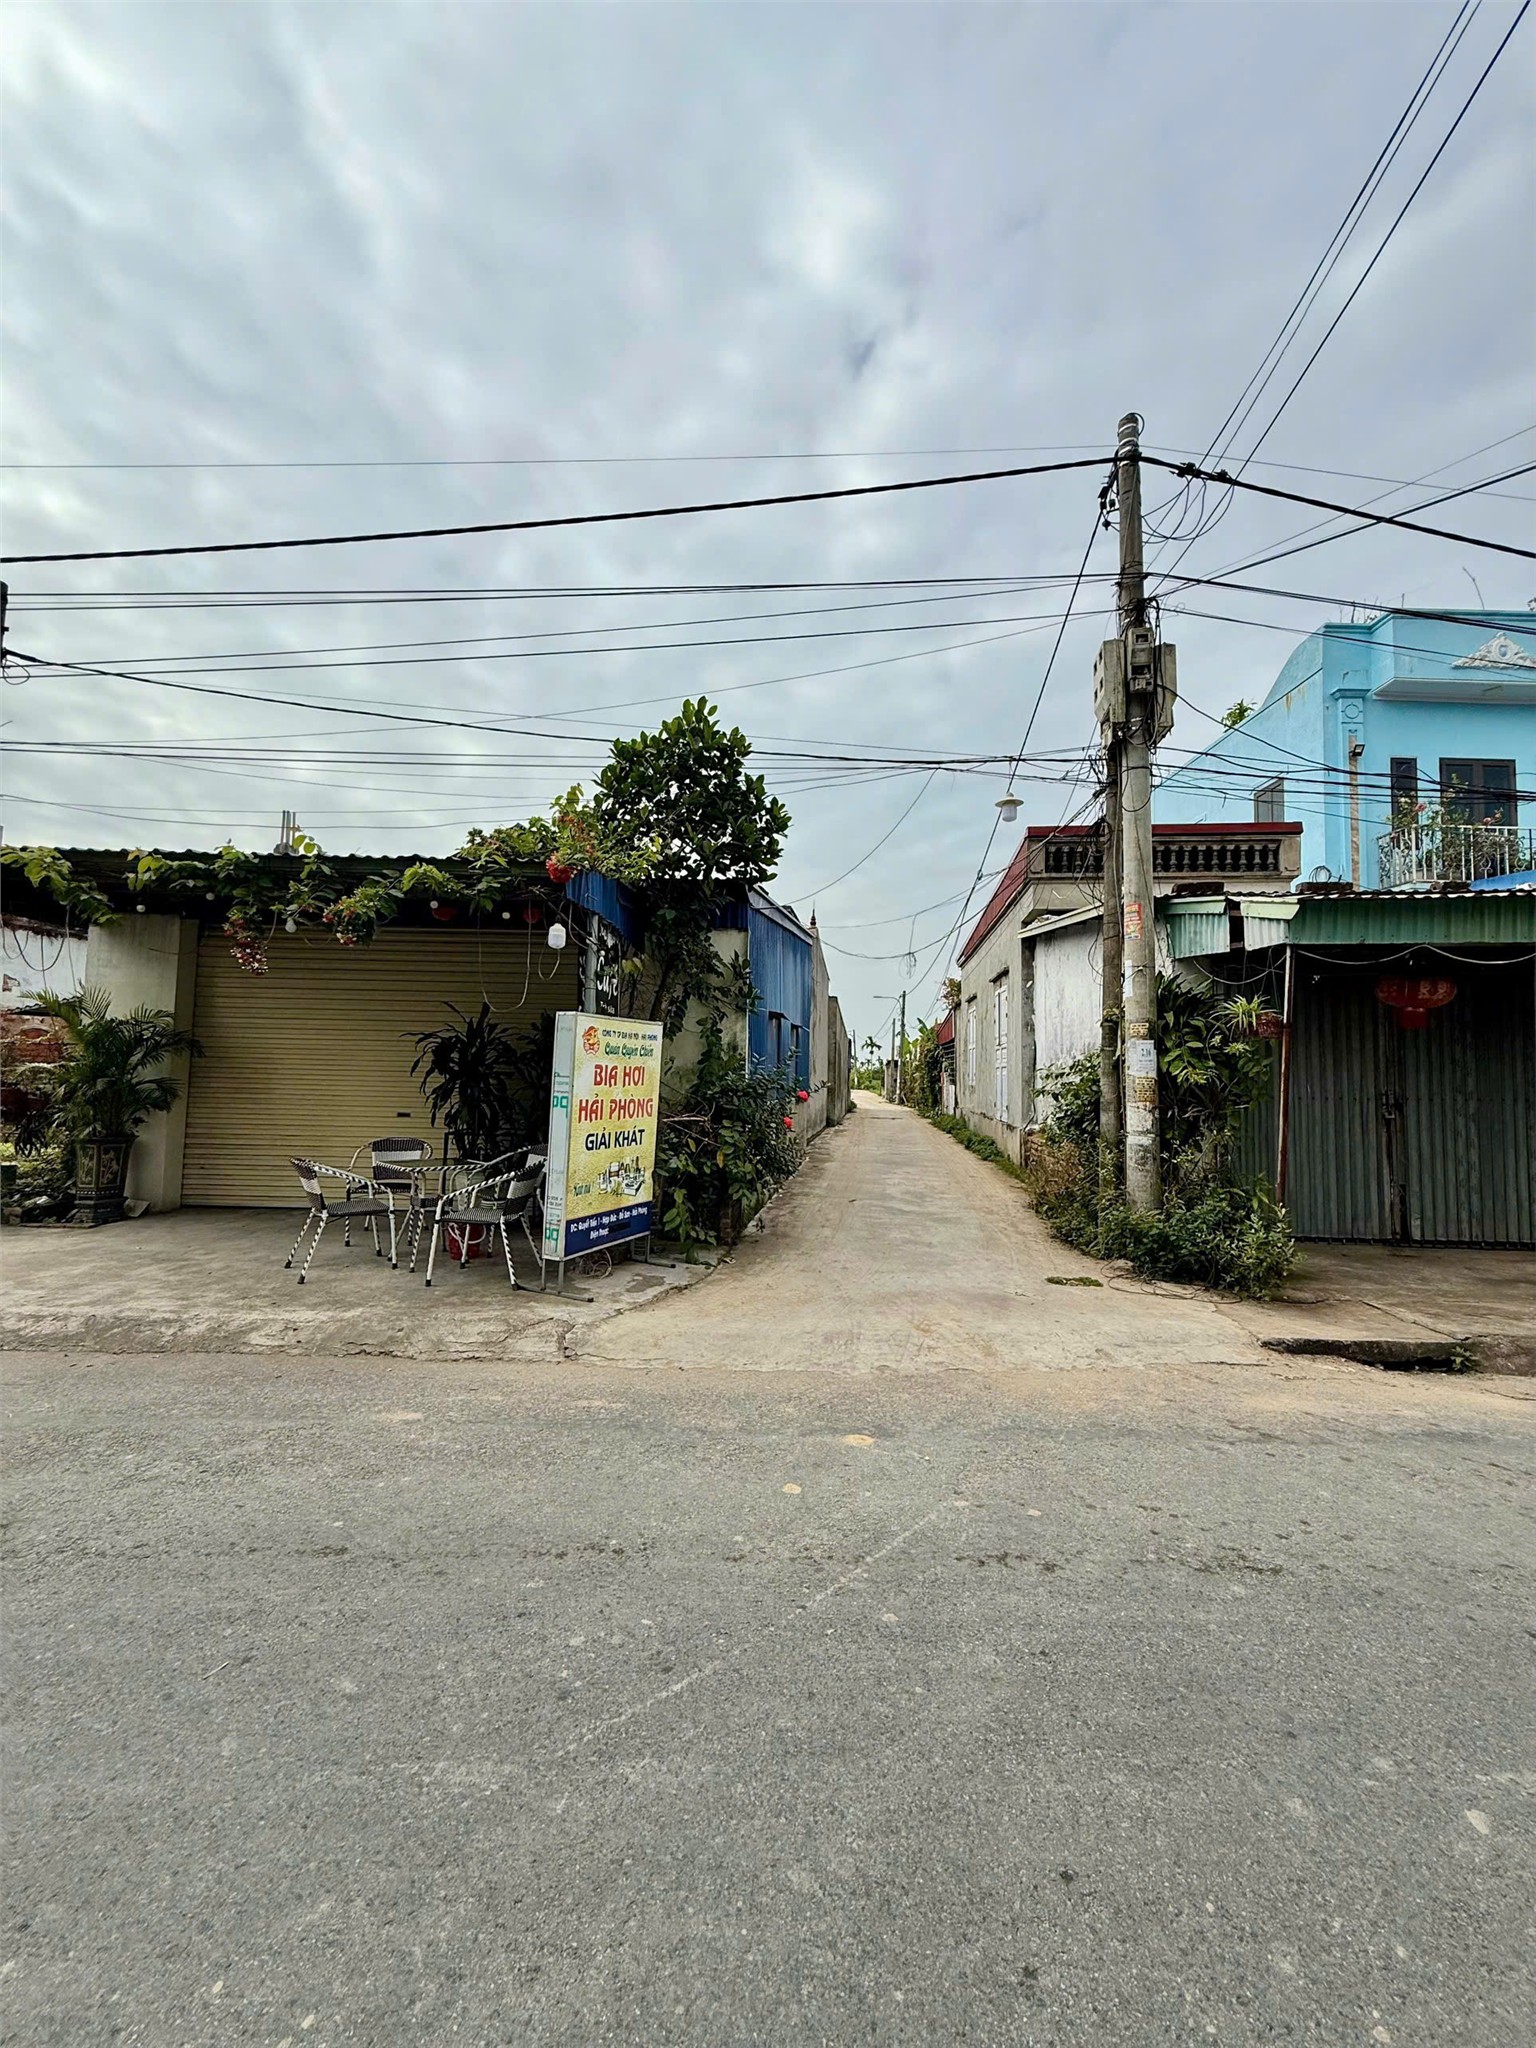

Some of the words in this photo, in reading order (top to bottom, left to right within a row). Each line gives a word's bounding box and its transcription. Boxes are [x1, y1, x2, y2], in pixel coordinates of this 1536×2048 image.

[593, 1064, 618, 1088] BIA
[622, 1065, 645, 1088] HƠI
[578, 1093, 604, 1124] HẢI
[608, 1093, 653, 1121] PHÒNG
[585, 1127, 611, 1151] GIẢI
[614, 1125, 645, 1149] KHÁT
